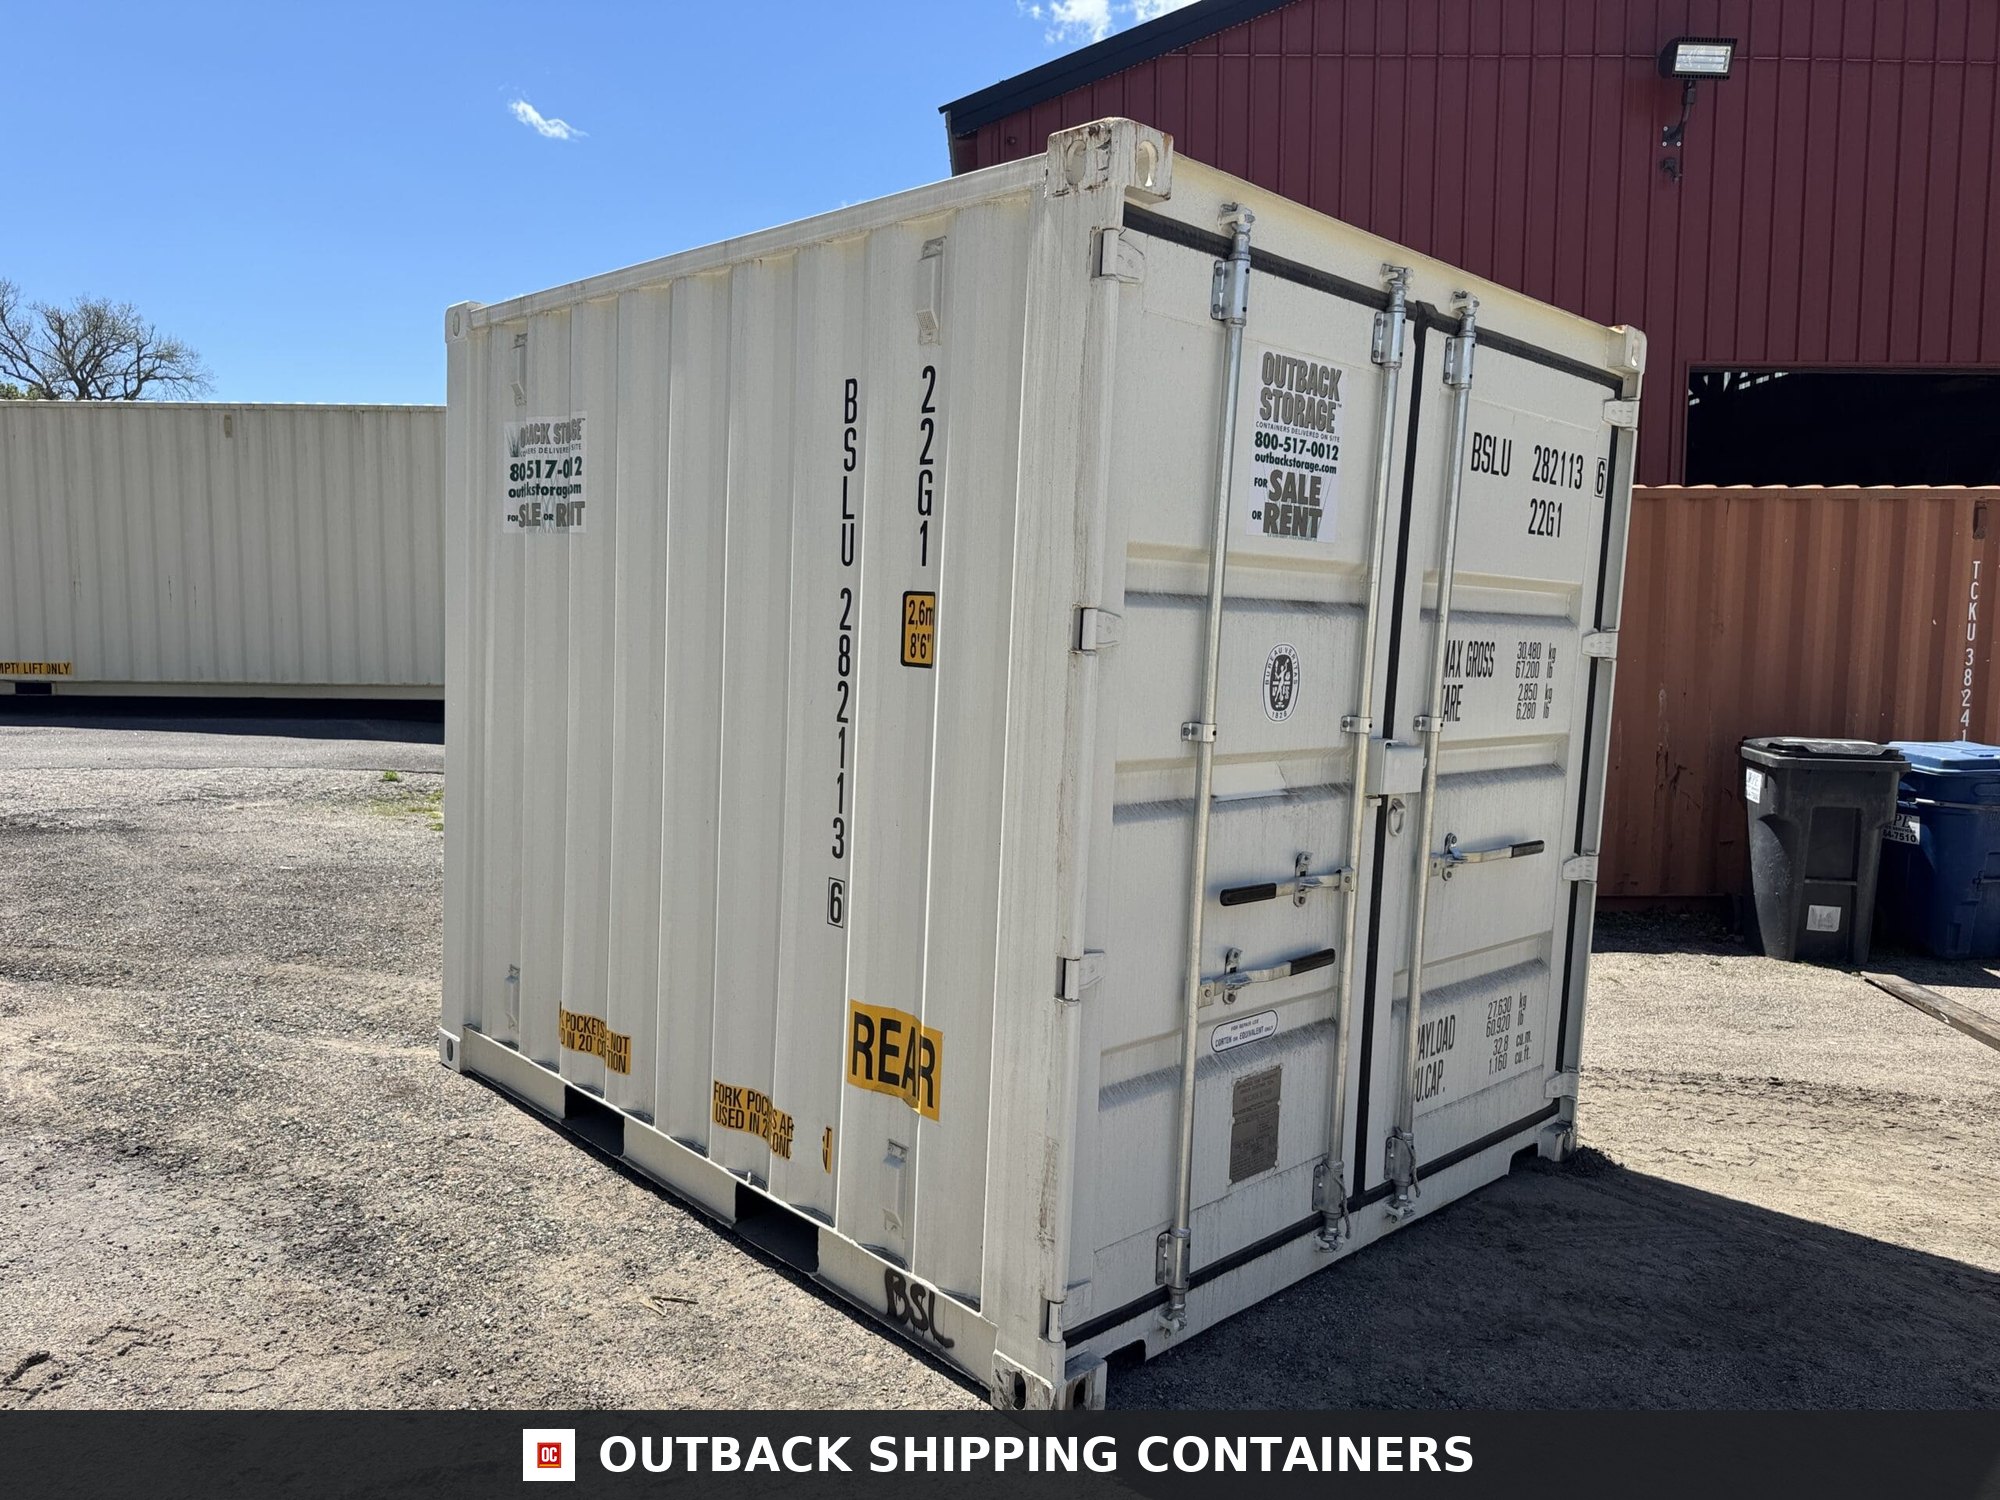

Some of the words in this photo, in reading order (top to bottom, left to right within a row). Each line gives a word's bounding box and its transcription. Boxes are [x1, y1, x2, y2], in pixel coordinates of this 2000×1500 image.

[1262, 351, 1342, 402] OUTBACK
[1259, 387, 1337, 434] STORAGE
[1254, 431, 1339, 461] 800-517-0012
[1256, 421, 1290, 433] CONTAINERS
[1291, 427, 1319, 439] DELIVERED
[1329, 435, 1340, 443] SITE
[841, 378, 858, 567] BSLU
[1254, 452, 1337, 475] outbackstorage.com
[1471, 432, 1512, 477] BSLU
[1532, 445, 1584, 490] 282113
[1596, 460, 1606, 495] 6
[1254, 477, 1268, 488] FOR
[1269, 469, 1322, 507] SALE
[543, 513, 554, 521] OR
[1251, 510, 1262, 520] OR
[1263, 502, 1323, 539] RENT
[1528, 498, 1562, 538] 22G1
[1965, 560, 1981, 642] TCKU
[23, 662, 43, 675] LIFT
[46, 662, 71, 675] ONLY
[1465, 640, 1495, 678] GROSS
[1548, 642, 1556, 663] kg
[1544, 682, 1552, 704] kg
[1960, 647, 1974, 742] 38241
[611, 1032, 630, 1055] NOT
[1418, 1014, 1455, 1061] AYLOAD
[1518, 991, 1527, 1010] kg
[851, 1011, 937, 1109] REAR
[713, 1080, 743, 1109] FORK
[715, 1103, 745, 1130] USED
[749, 1111, 761, 1135] IN
[884, 1267, 955, 1349] BSL
